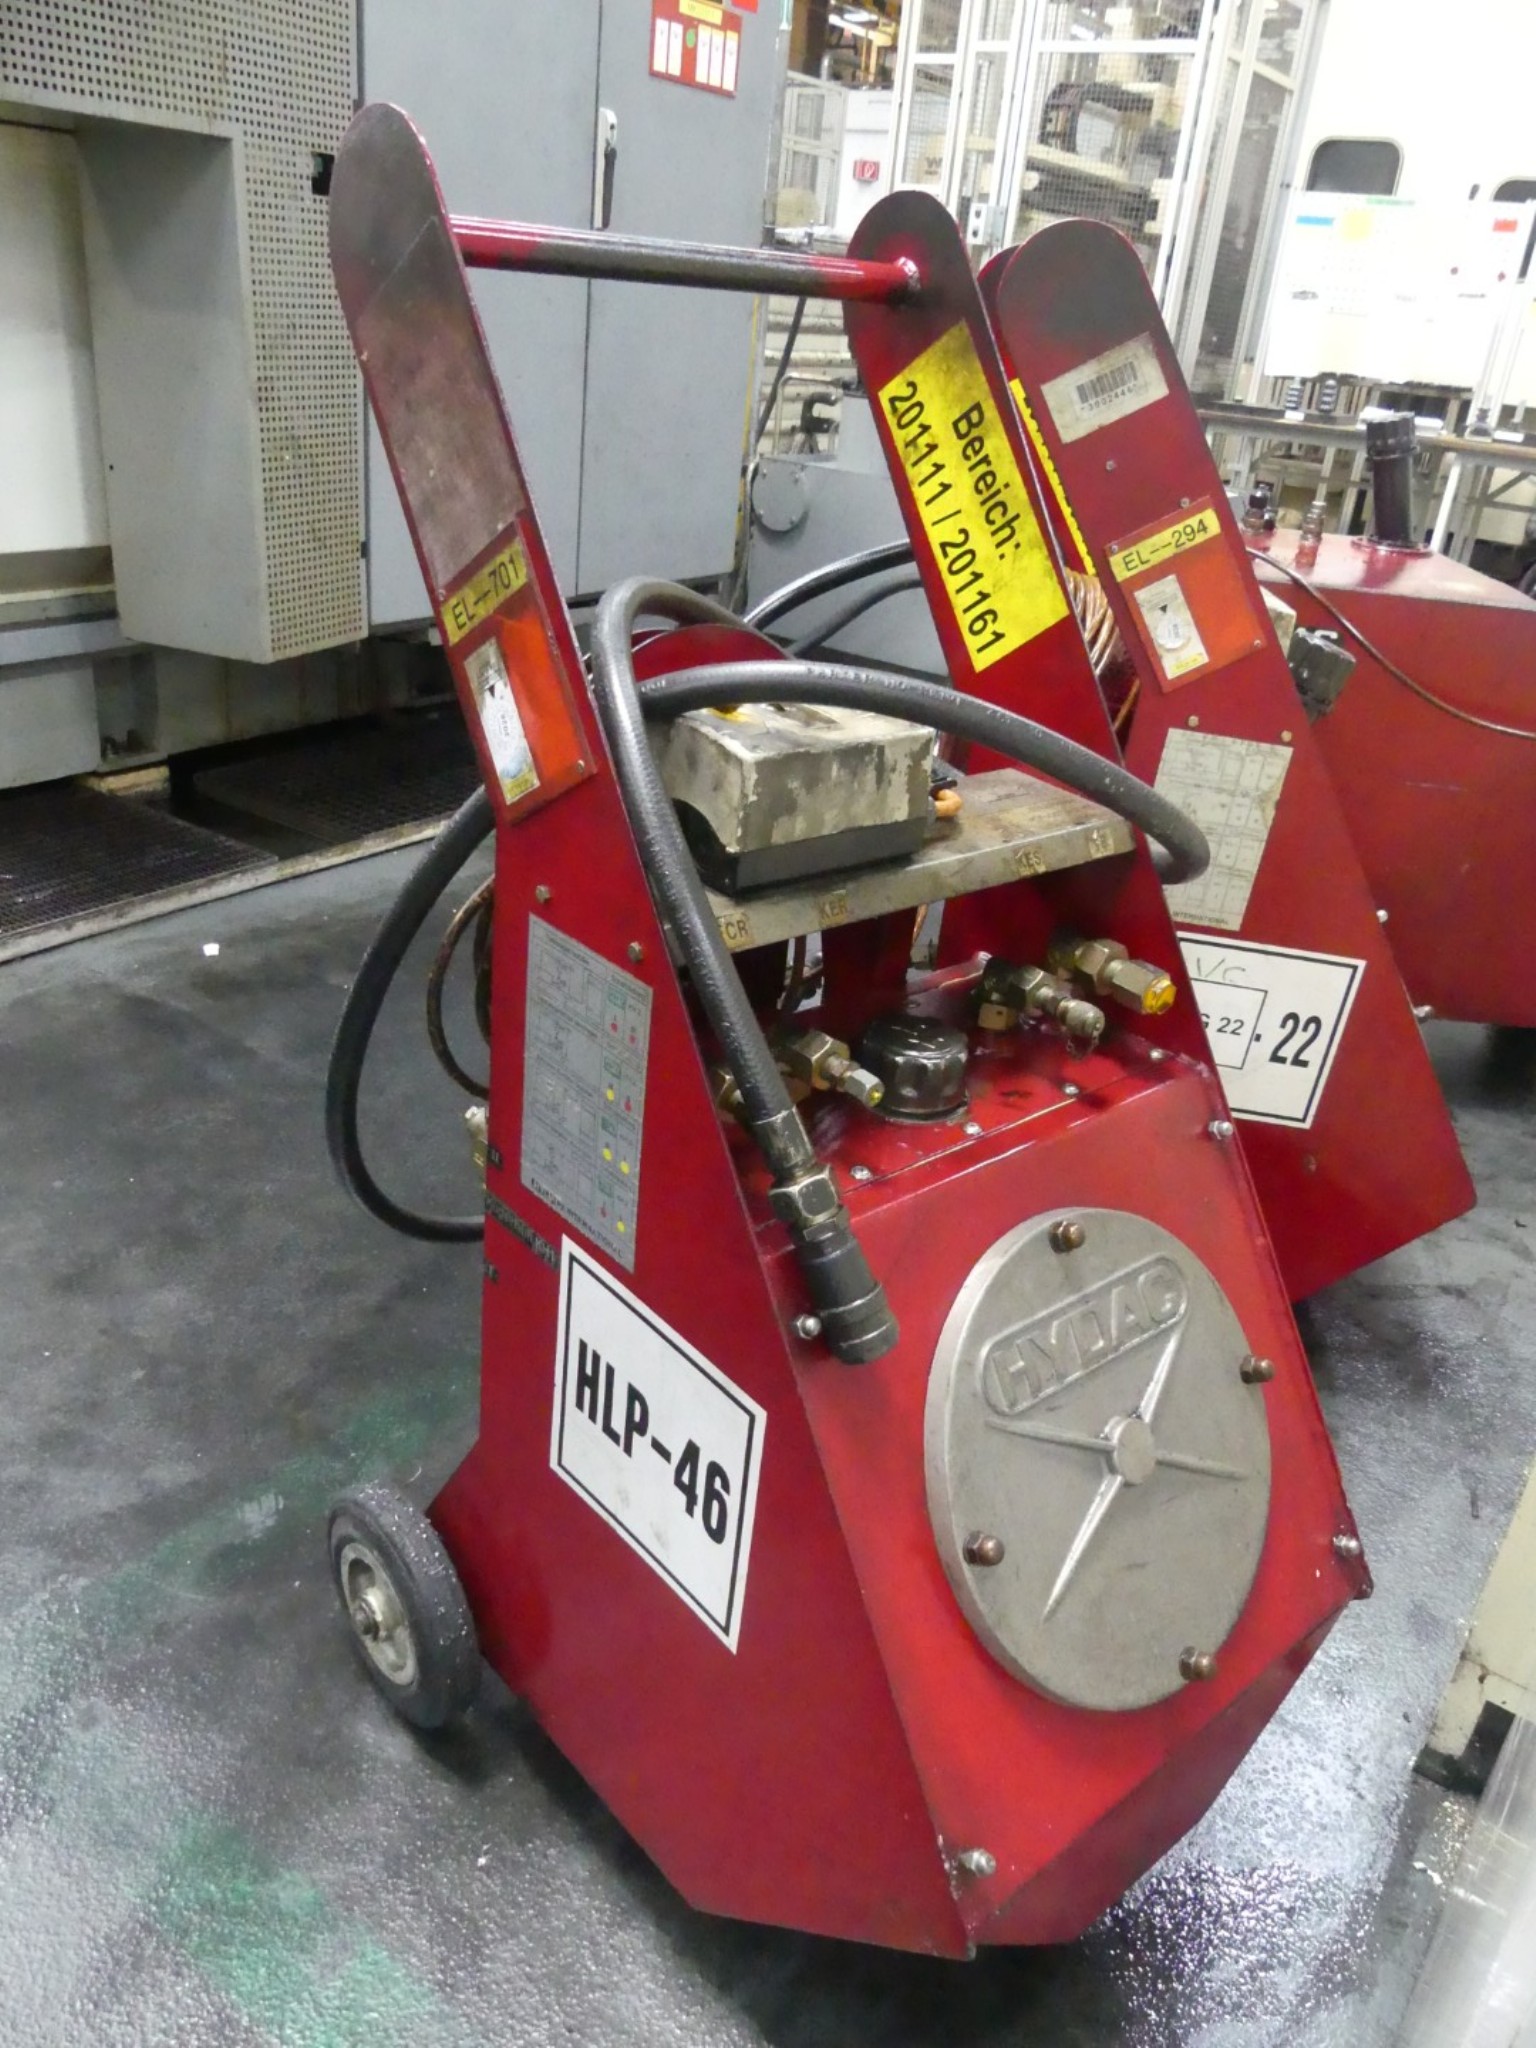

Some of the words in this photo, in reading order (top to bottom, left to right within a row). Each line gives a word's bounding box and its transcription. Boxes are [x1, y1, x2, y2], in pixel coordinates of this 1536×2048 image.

[888, 381, 953, 507] 201111
[940, 528, 1006, 654] 201161
[952, 401, 1021, 560] Bereich:
[1216, 1016, 1245, 1036] 22
[989, 1263, 1178, 1410] HYDAC
[575, 1337, 731, 1545] HLP-46
